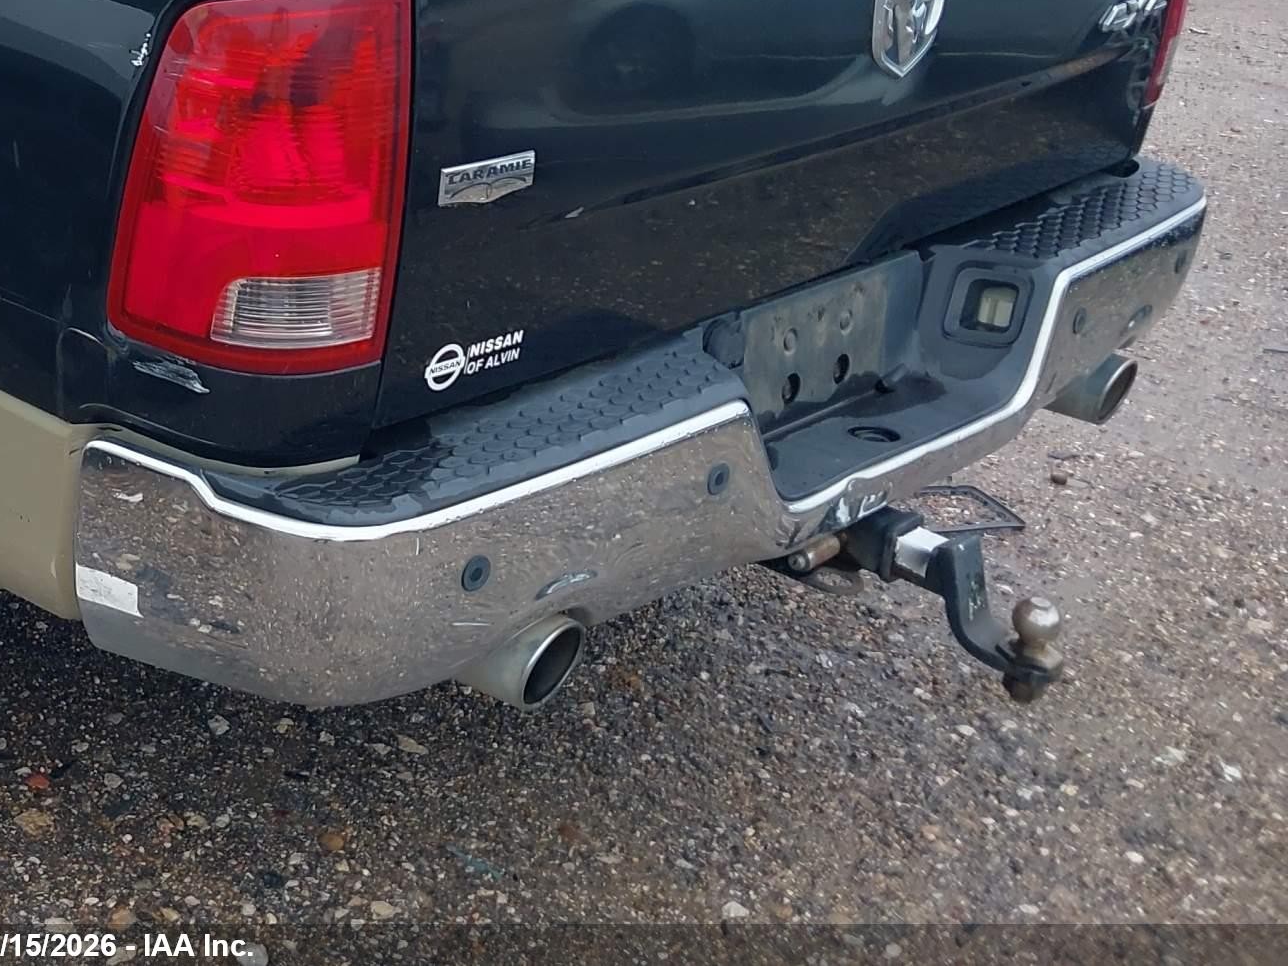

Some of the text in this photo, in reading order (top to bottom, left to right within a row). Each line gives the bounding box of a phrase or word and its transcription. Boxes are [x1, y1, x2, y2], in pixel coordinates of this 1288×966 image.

[445, 158, 532, 186] LARAMIE
[469, 330, 524, 358] NISSAN
[430, 360, 462, 375] NISSAN
[467, 347, 521, 375] OF ALVIN
